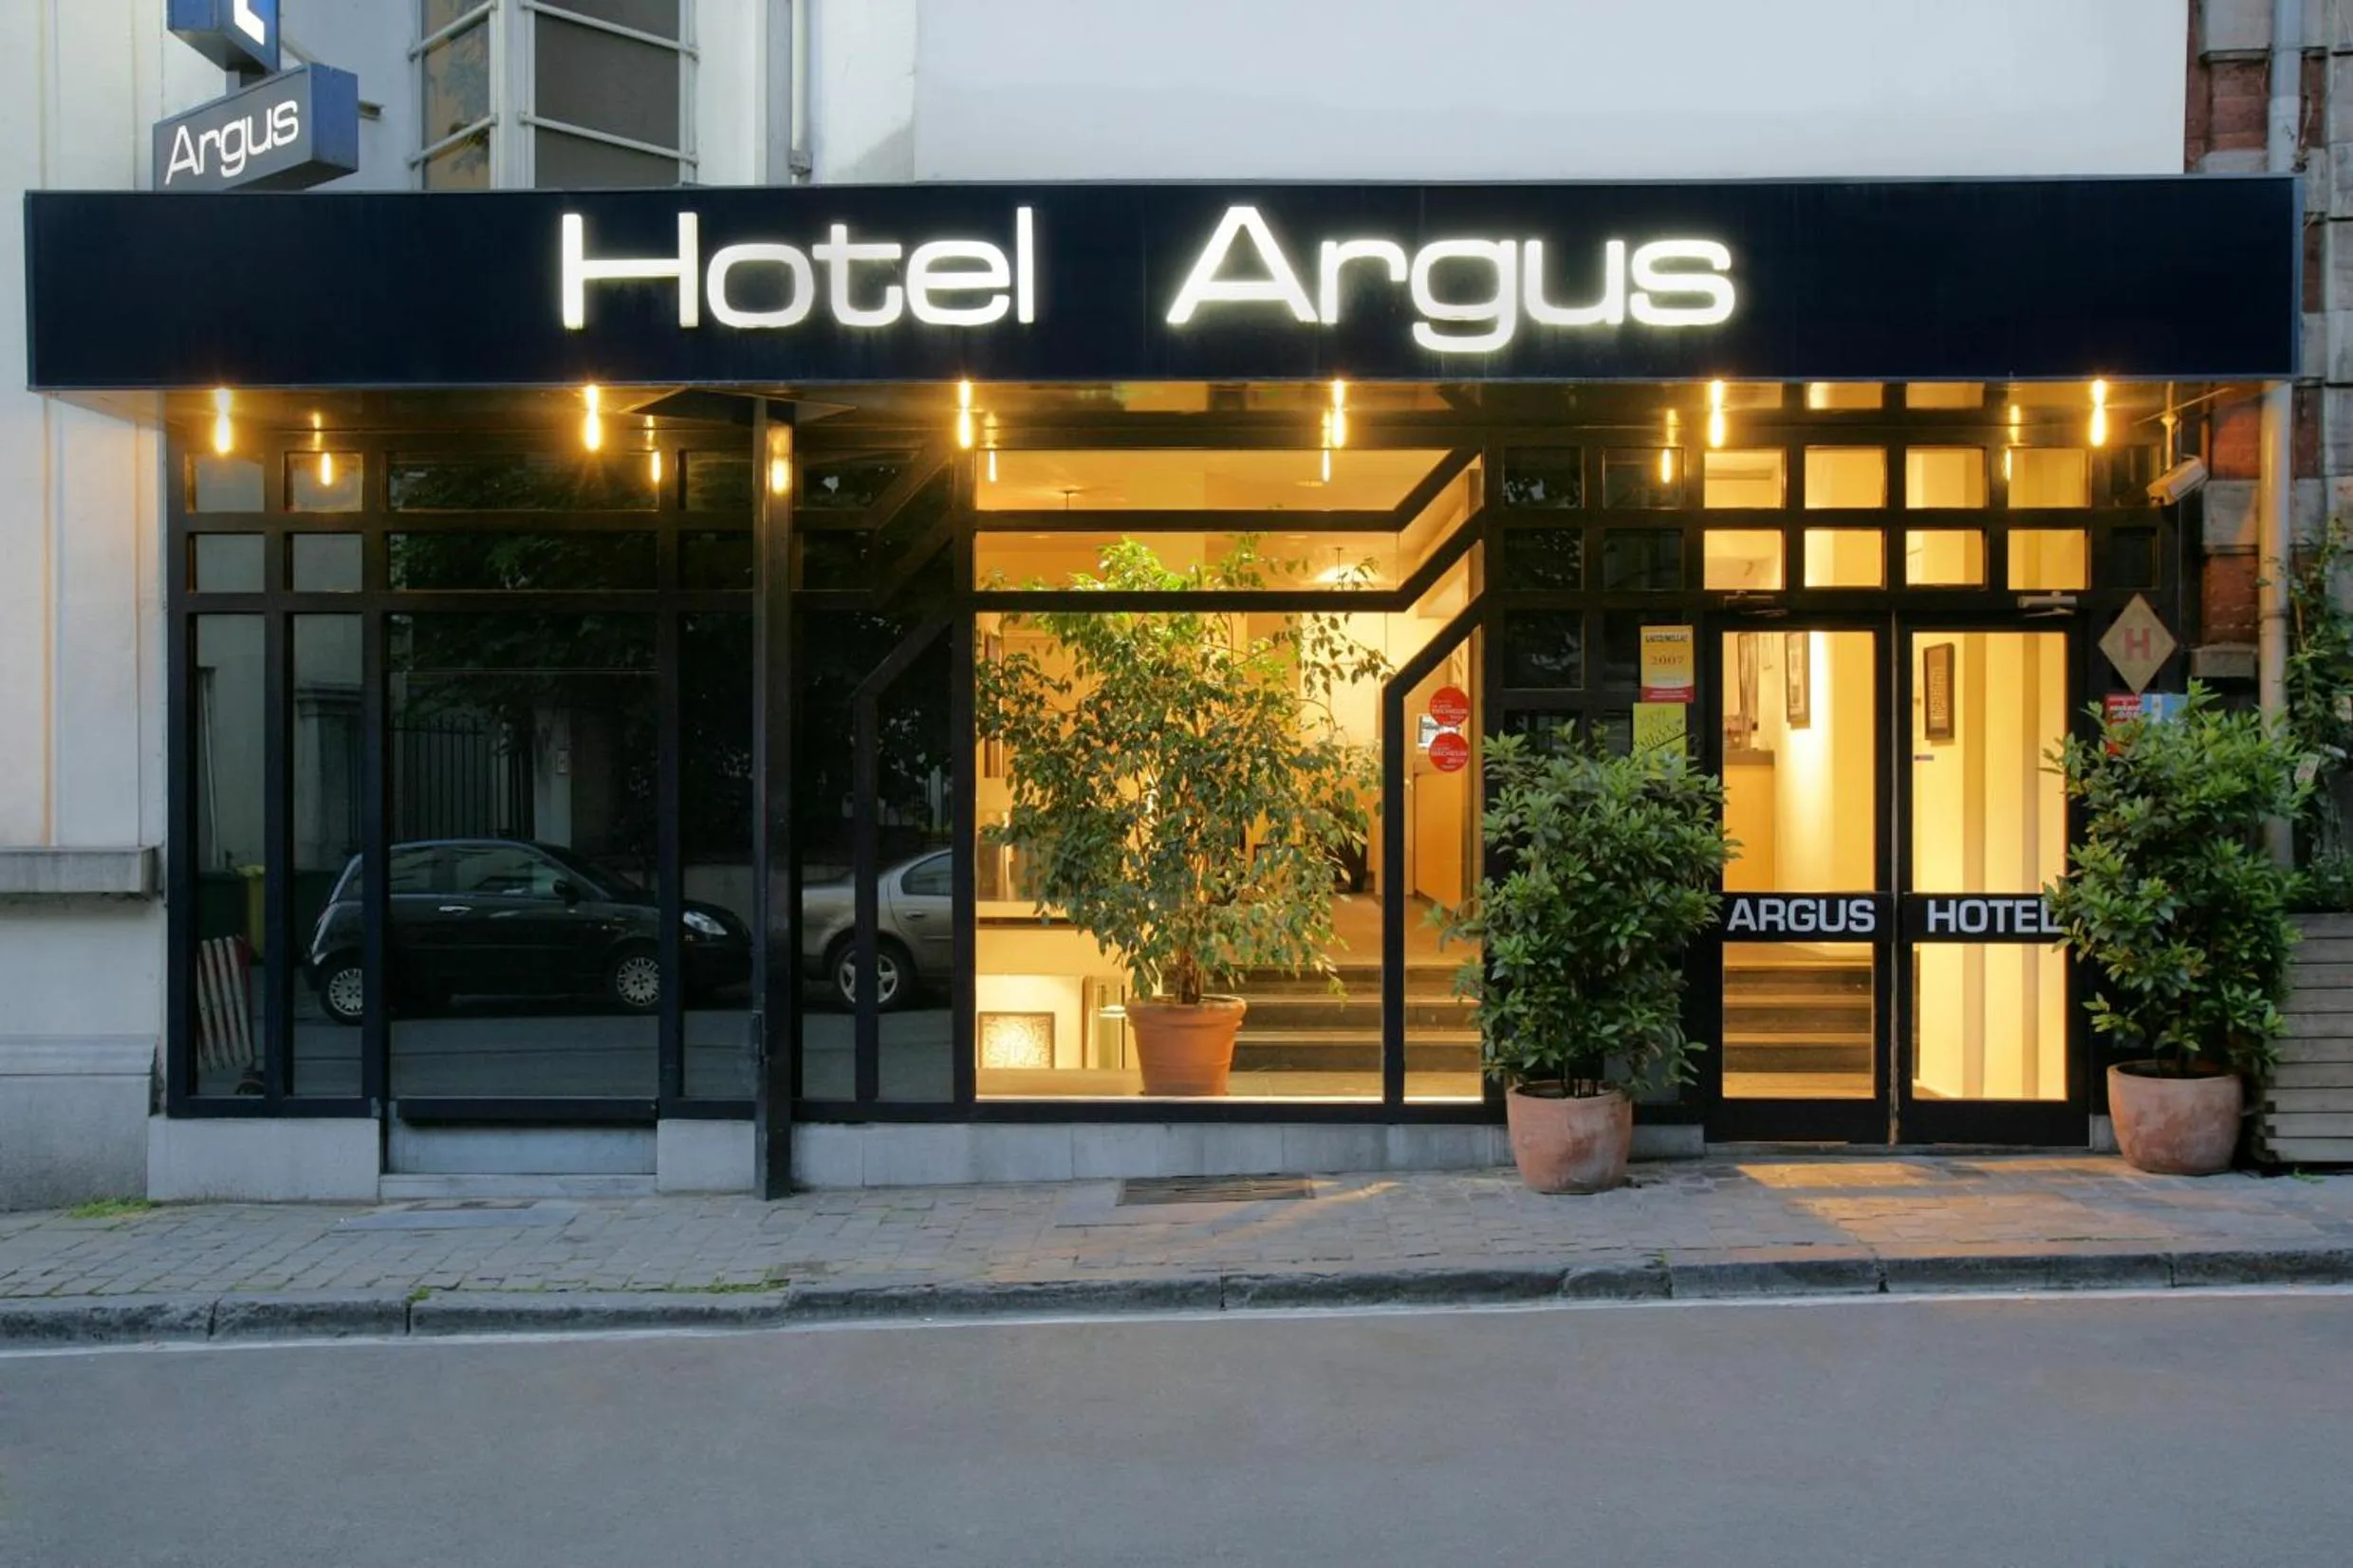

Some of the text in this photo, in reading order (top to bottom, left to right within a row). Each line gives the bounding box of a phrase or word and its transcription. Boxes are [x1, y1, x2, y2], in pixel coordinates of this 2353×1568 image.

[164, 100, 299, 185] Argus
[560, 205, 1738, 355] Hotel Argus
[1651, 655, 1685, 666] 2007
[2124, 627, 2151, 662] H
[1727, 898, 2065, 933] ARGUS HOTEL
